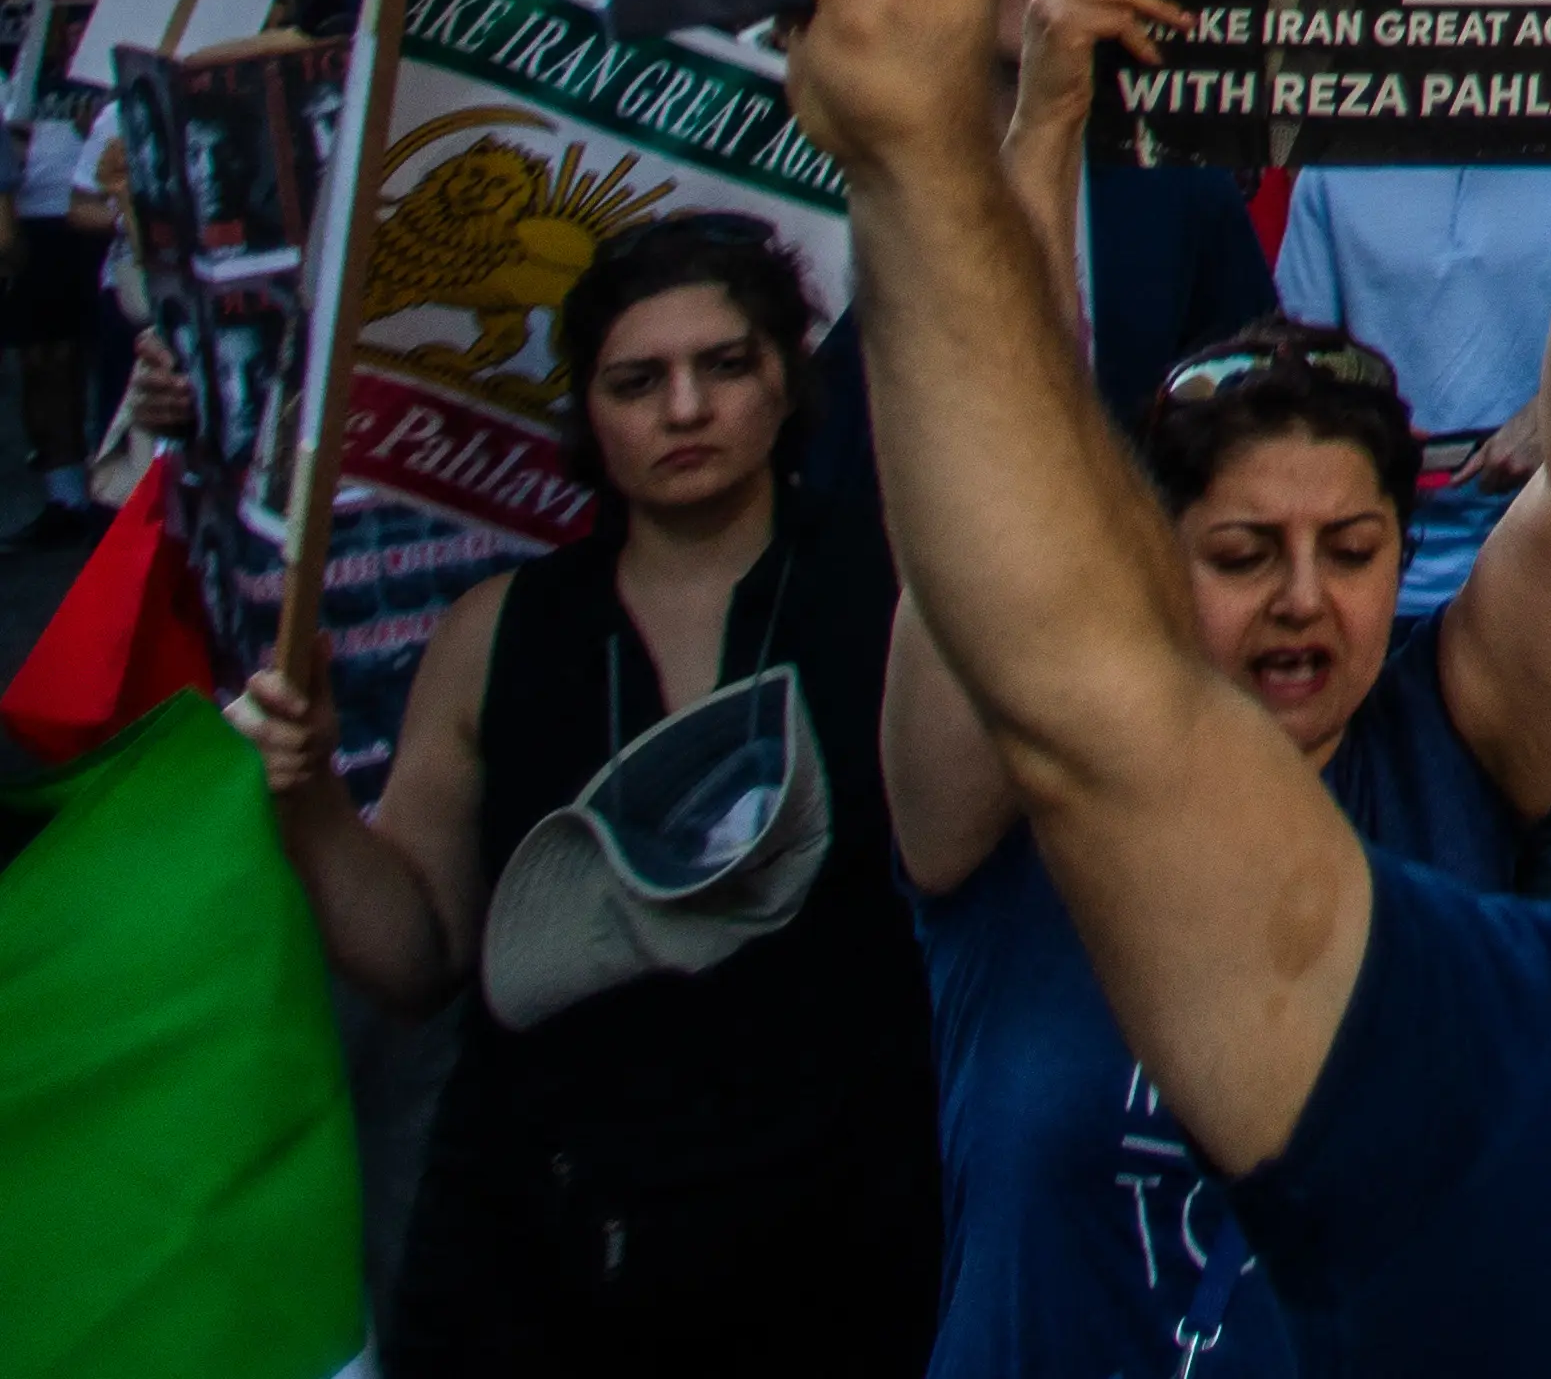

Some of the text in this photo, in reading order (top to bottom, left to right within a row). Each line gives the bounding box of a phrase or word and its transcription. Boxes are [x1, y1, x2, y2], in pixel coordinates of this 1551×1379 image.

[1262, 9, 1364, 45] IRAN
[1374, 9, 1510, 46] GREAT
[489, 7, 639, 103] IRAN
[616, 58, 775, 157] GREAT
[1117, 68, 1256, 114] WITH
[1271, 71, 1408, 116] REZA
[365, 404, 597, 528] Pahlavi
